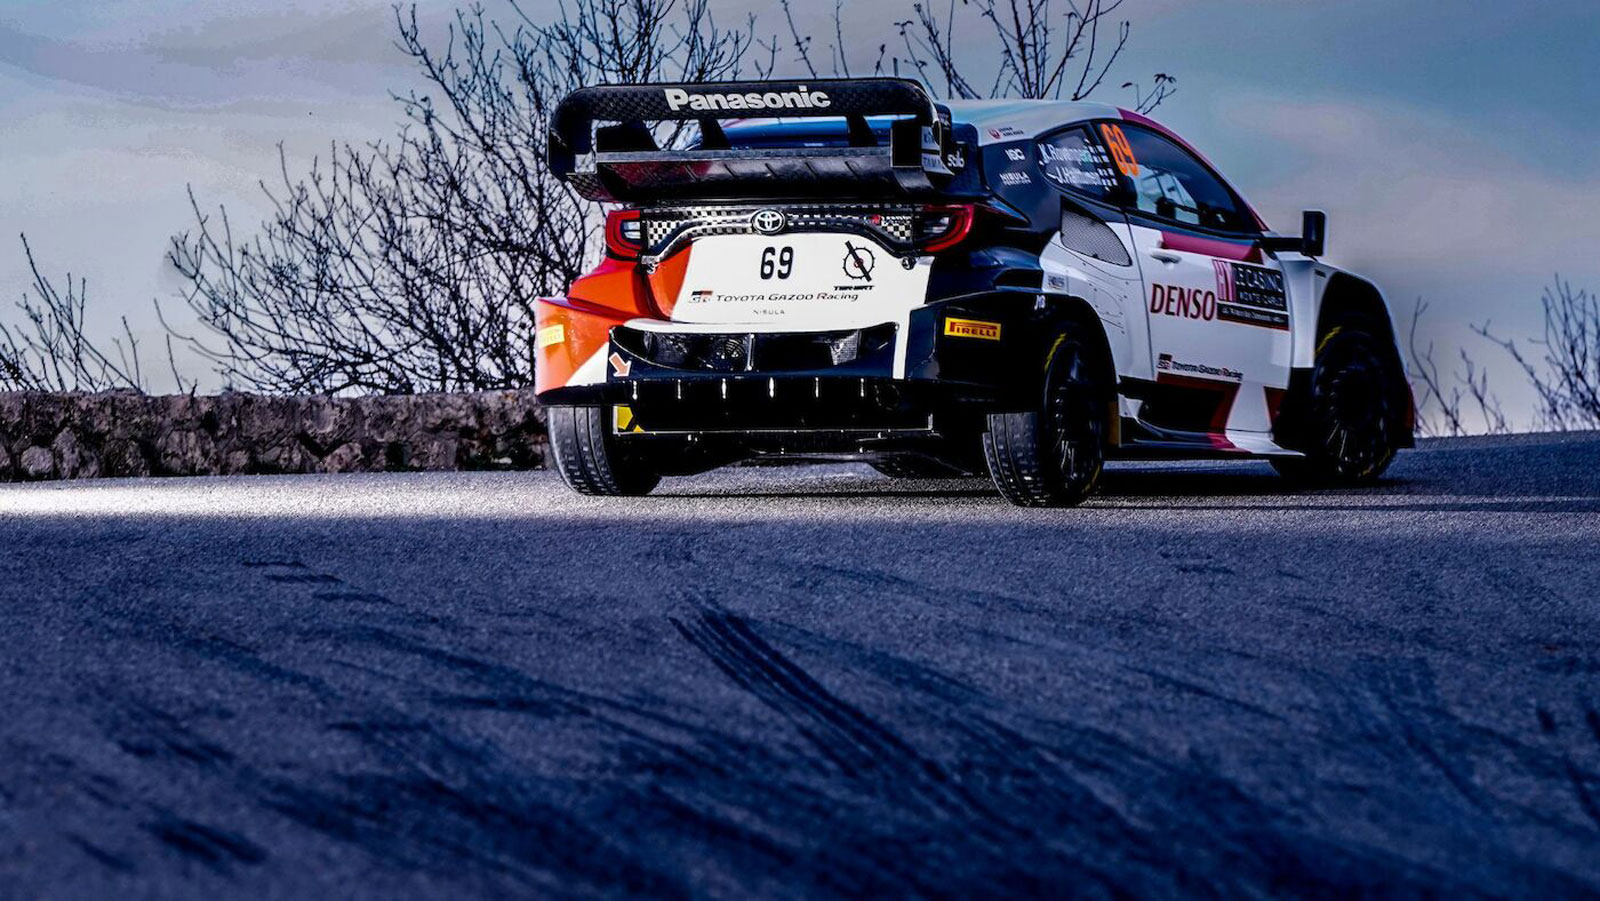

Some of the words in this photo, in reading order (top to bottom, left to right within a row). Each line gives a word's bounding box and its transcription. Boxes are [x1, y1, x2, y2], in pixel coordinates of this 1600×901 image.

[664, 85, 831, 111] Panasonic
[1101, 123, 1139, 176] 69
[760, 246, 794, 280] 69
[716, 294, 766, 302] TOYOTA
[768, 293, 814, 301] GAZOO
[816, 292, 858, 302] Racing
[1150, 283, 1216, 321] DENSO
[949, 321, 998, 337] PIRELLI
